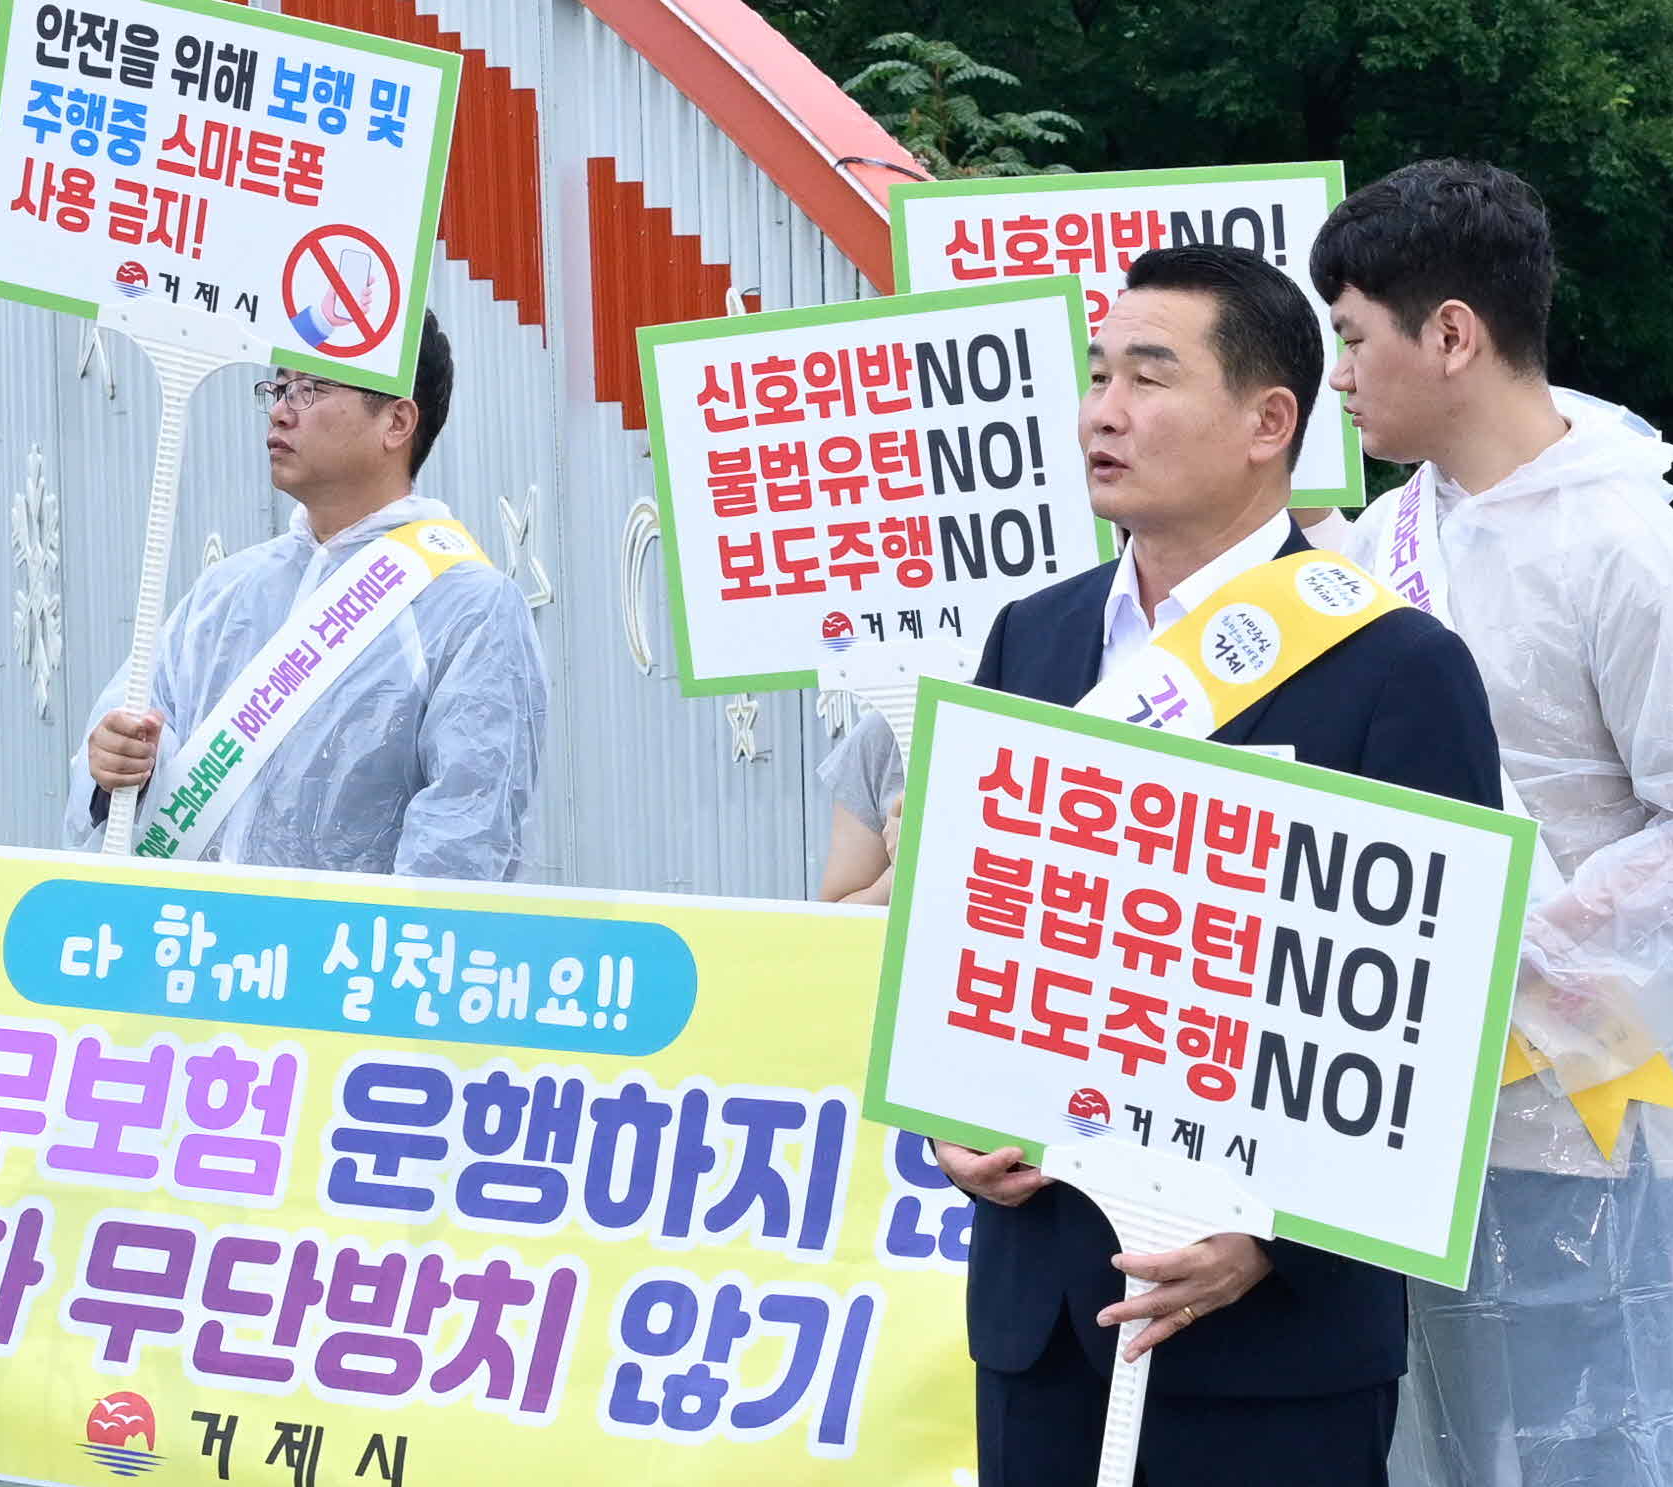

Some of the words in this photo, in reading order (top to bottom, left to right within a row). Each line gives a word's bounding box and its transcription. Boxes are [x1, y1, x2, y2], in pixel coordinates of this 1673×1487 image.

[35, 3, 160, 90] 안전을
[170, 34, 258, 112] 위해
[268, 56, 354, 135] 보행
[367, 78, 411, 149] 및
[22, 79, 149, 167] 주행중
[156, 113, 326, 208] 스마트폰
[10, 157, 97, 233] 사용
[108, 177, 208, 260] 금지!
[158, 271, 259, 324] 거제시
[309, 554, 407, 650] 바로보자
[860, 605, 963, 642] 거제시
[230, 640, 322, 743] 교통신호
[1214, 632, 1246, 676] 거제
[153, 903, 289, 1005] 함께
[322, 914, 635, 1033] 실천해요!!
[329, 1060, 847, 1253] 운행하지
[1123, 1104, 1258, 1176] 거제시
[68, 1218, 578, 1415] 무단방치
[608, 1276, 876, 1448] 않기
